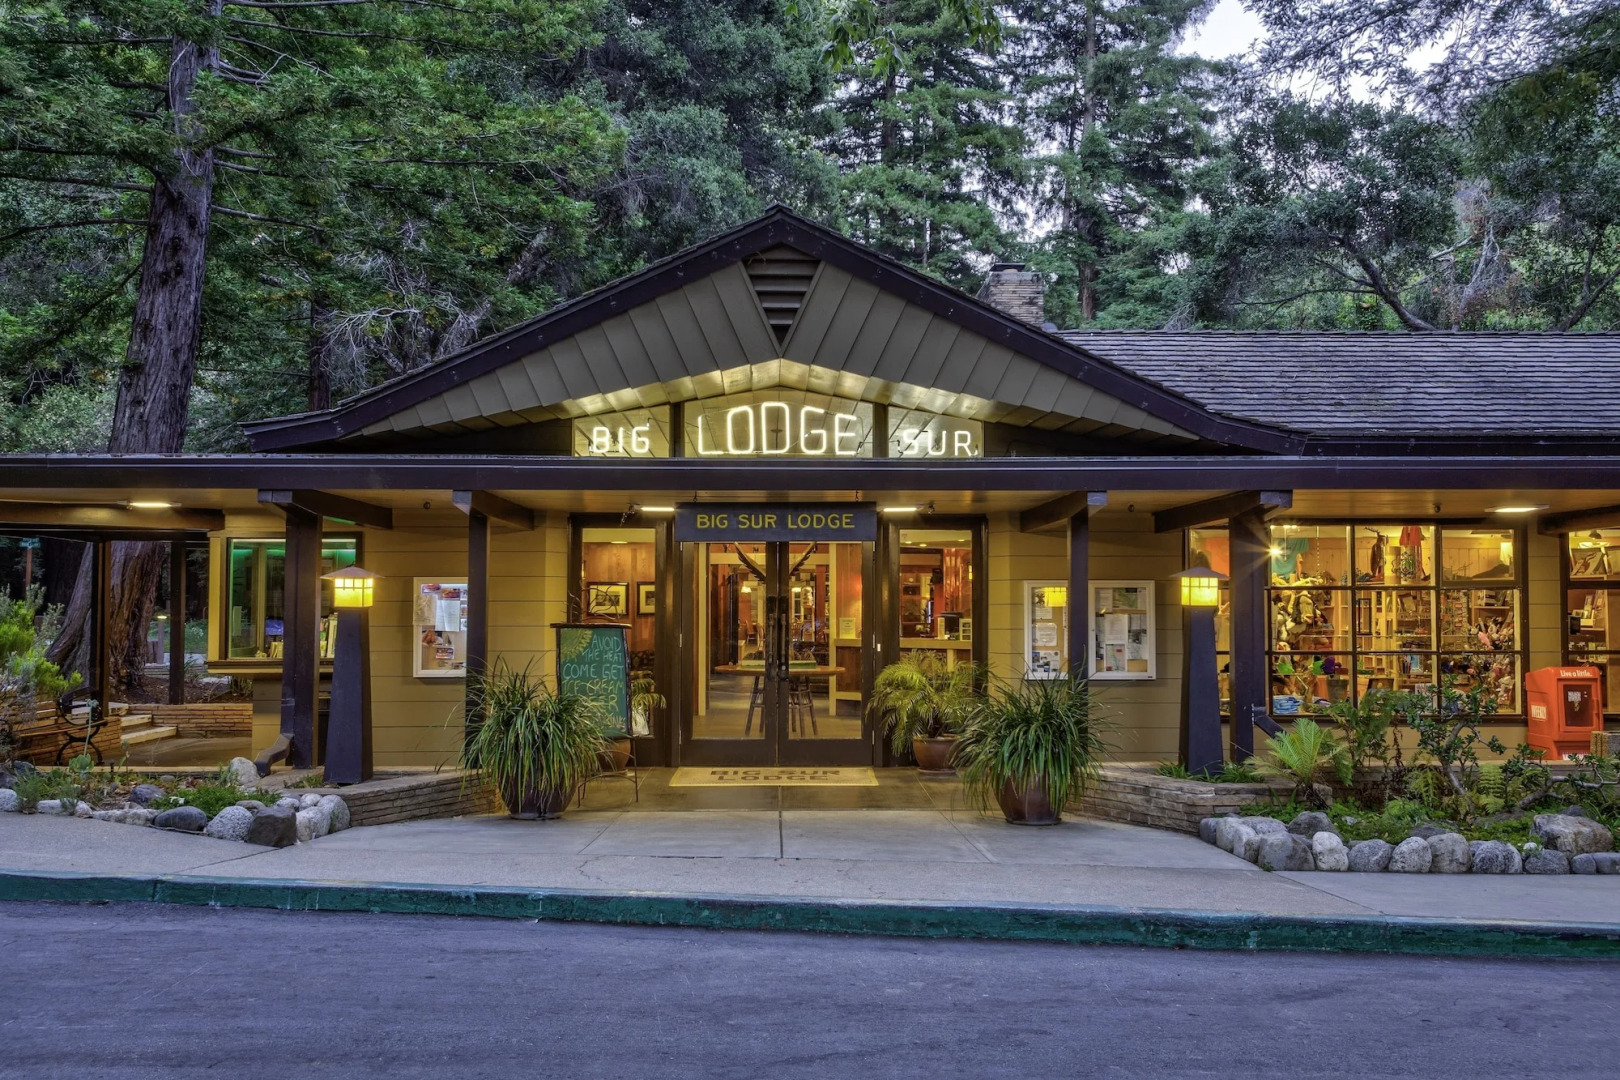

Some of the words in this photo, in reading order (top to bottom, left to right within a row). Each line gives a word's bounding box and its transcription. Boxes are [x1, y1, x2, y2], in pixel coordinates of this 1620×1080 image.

[592, 426, 650, 453] BIG
[698, 401, 857, 455] LODGE
[902, 428, 972, 456] SUR
[696, 514, 729, 529] BIG
[738, 514, 777, 529] SUR
[787, 513, 855, 529] LODGE
[591, 634, 621, 651] AVOID
[582, 648, 600, 662] THE
[603, 650, 622, 662] HEAT
[562, 663, 597, 680] COME
[602, 663, 624, 680] GET
[587, 679, 625, 696] CREAM
